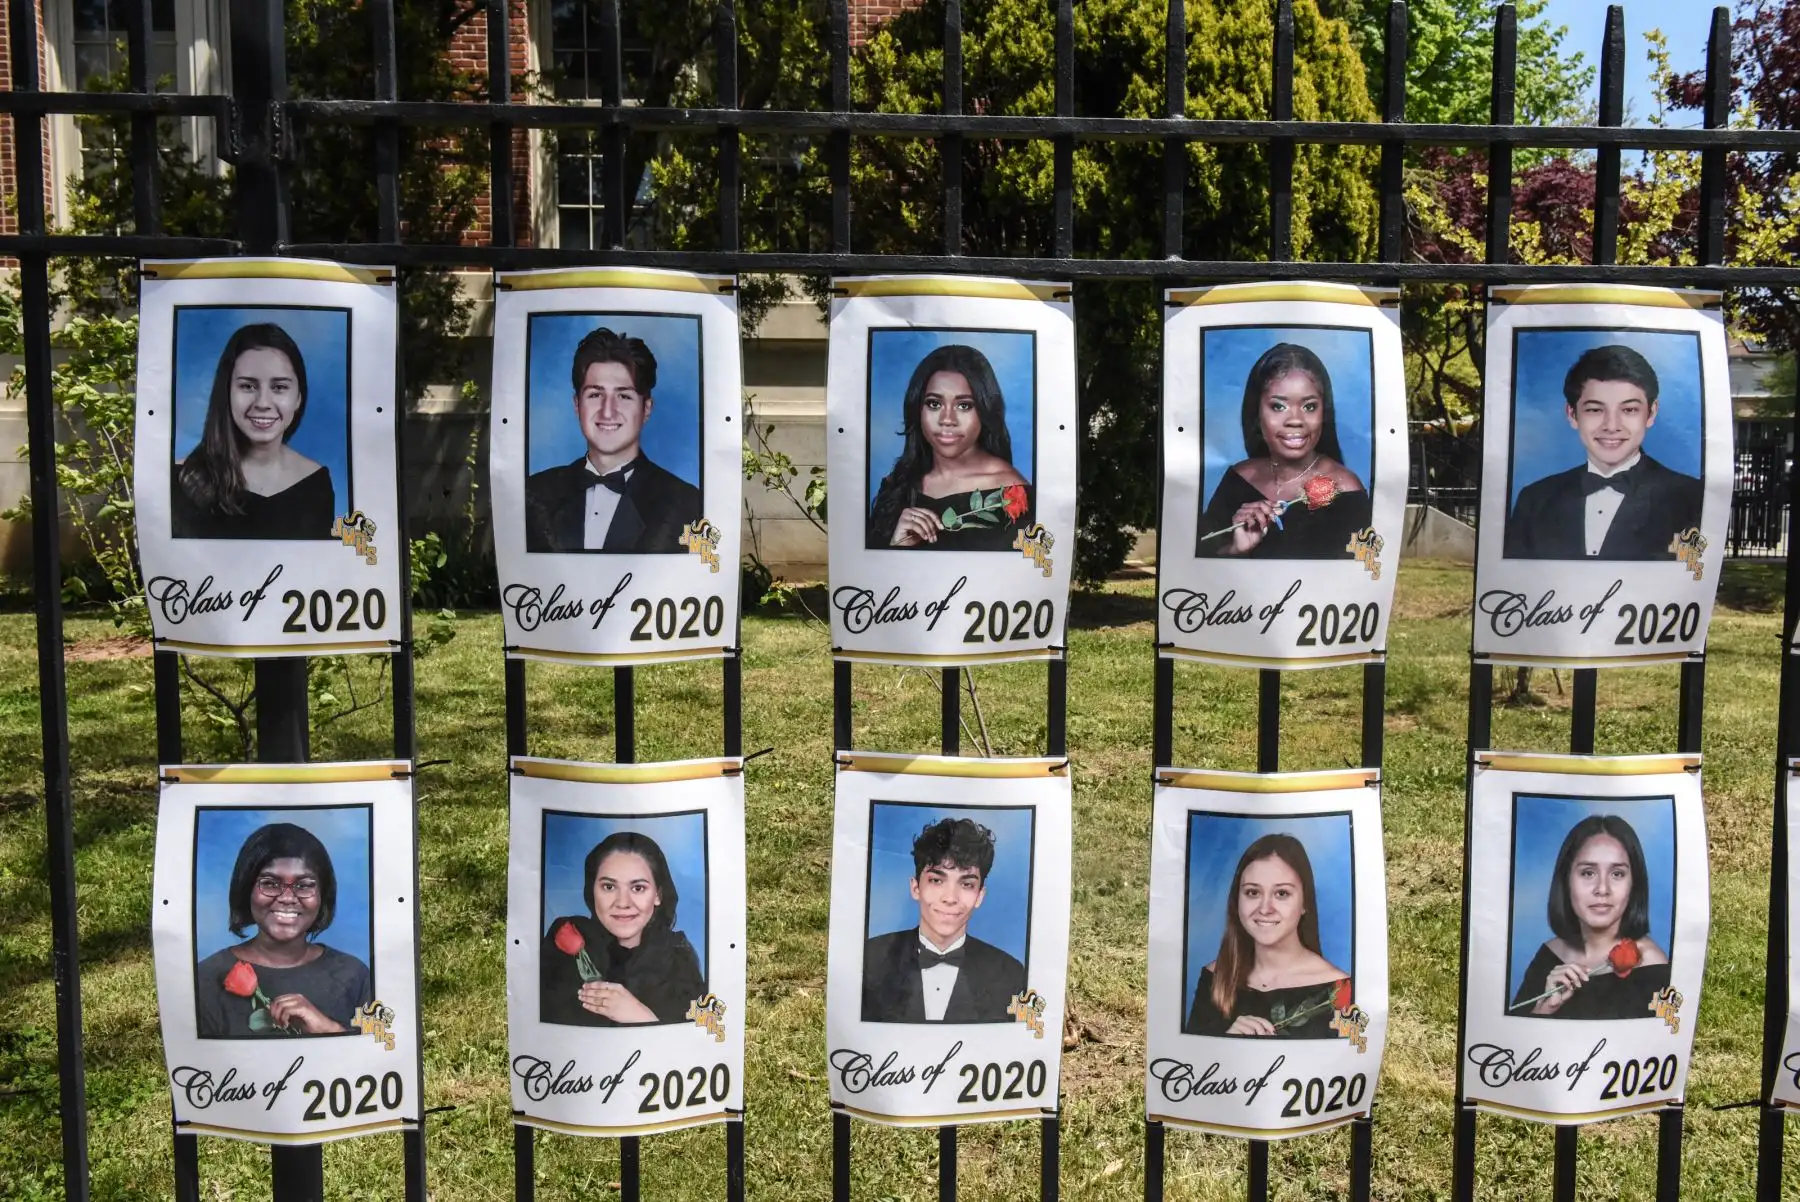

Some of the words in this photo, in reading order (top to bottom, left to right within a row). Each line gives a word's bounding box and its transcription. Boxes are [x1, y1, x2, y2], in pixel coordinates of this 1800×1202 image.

[331, 516, 377, 566] JMHS
[678, 523, 720, 574] JMHS
[1012, 528, 1053, 577] JMHS
[1346, 531, 1381, 580] JMHS
[1668, 532, 1704, 581] JMHS
[147, 575, 234, 625] Class
[239, 563, 284, 622] of
[281, 587, 386, 633] 2020
[502, 583, 585, 633] Class
[589, 572, 633, 630] of
[629, 595, 724, 642] 2020
[832, 585, 919, 635] Class
[924, 575, 968, 632] of
[962, 598, 1054, 643] 2020
[1161, 587, 1254, 634] Class
[1258, 579, 1302, 635] of
[1295, 601, 1380, 647] 2020
[1478, 589, 1574, 638] Class
[1579, 579, 1623, 634] of
[1614, 601, 1701, 645] 2020
[351, 1007, 395, 1051] JMHS
[686, 999, 725, 1043] JMHS
[1007, 995, 1044, 1039] JMHS
[1329, 1010, 1368, 1054] JMHS
[1648, 992, 1680, 1034] JMHS
[171, 1065, 257, 1110] Class
[262, 1055, 305, 1111] of
[302, 1070, 403, 1122] 2020
[512, 1054, 594, 1102] Class
[599, 1049, 642, 1105] of
[638, 1062, 730, 1114] 2020
[829, 1048, 916, 1094] Class
[921, 1040, 963, 1094] of
[957, 1059, 1047, 1104] 2020
[1149, 1057, 1238, 1103] Class
[1243, 1054, 1286, 1106] of
[1280, 1072, 1367, 1118] 2020
[1467, 1043, 1560, 1089] Class
[1565, 1038, 1607, 1091] of
[1599, 1053, 1678, 1101] 2020
